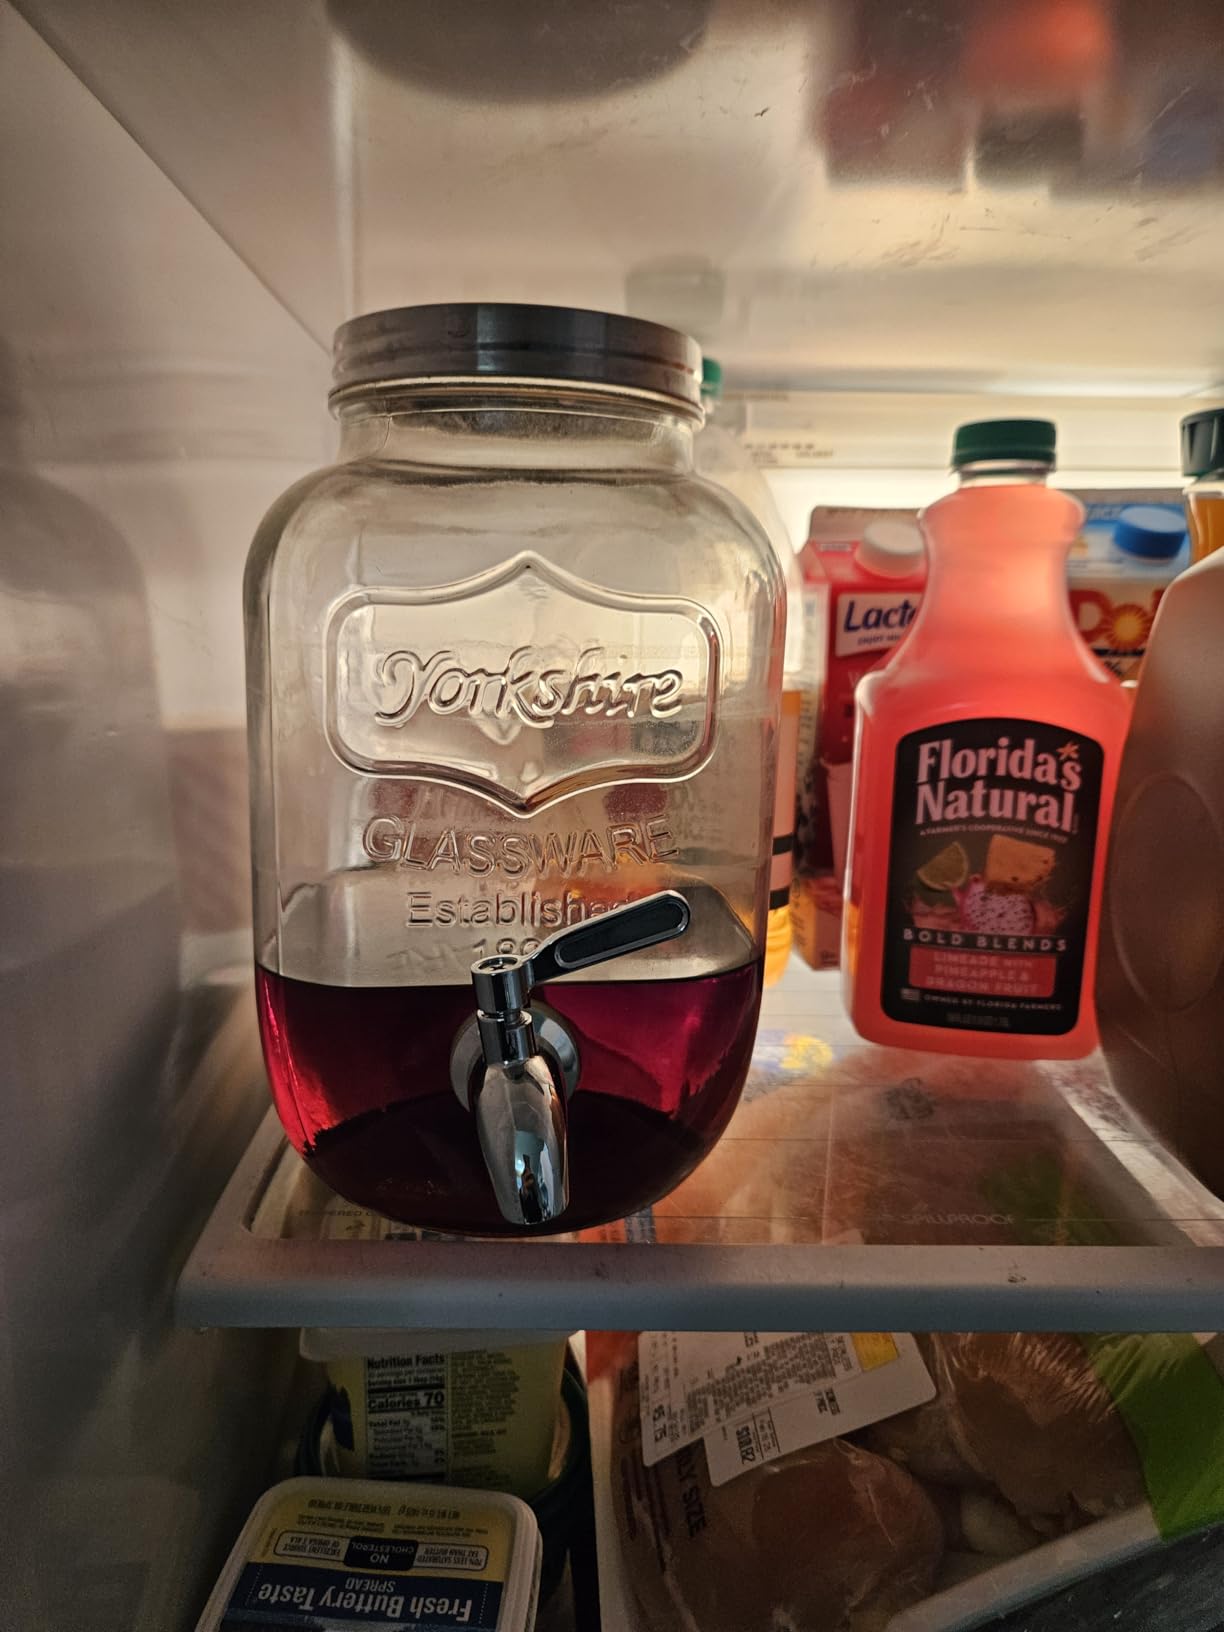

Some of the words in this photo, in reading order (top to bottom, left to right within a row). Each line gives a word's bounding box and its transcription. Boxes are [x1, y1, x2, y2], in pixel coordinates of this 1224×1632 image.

[373, 645, 683, 729] Yorkshire
[916, 737, 1084, 791] Florida's
[915, 779, 1076, 834] Natural
[362, 813, 681, 880] GLASSWARE
[903, 928, 963, 946] BOLD
[976, 935, 1069, 952] BLENDS
[933, 964, 1015, 981] PINEAPPLE
[367, 1355, 413, 1370] Nutrition
[415, 1352, 445, 1367] Facts
[367, 1396, 421, 1411] Calories
[424, 1391, 445, 1406] 70
[351, 1541, 415, 1554] CHOLESTEROL
[369, 1553, 390, 1564] NO
[258, 1583, 315, 1611] Taste
[345, 1577, 396, 1592] SPREAD
[319, 1585, 405, 1619] Buttery
[409, 1596, 473, 1622] Fresh
